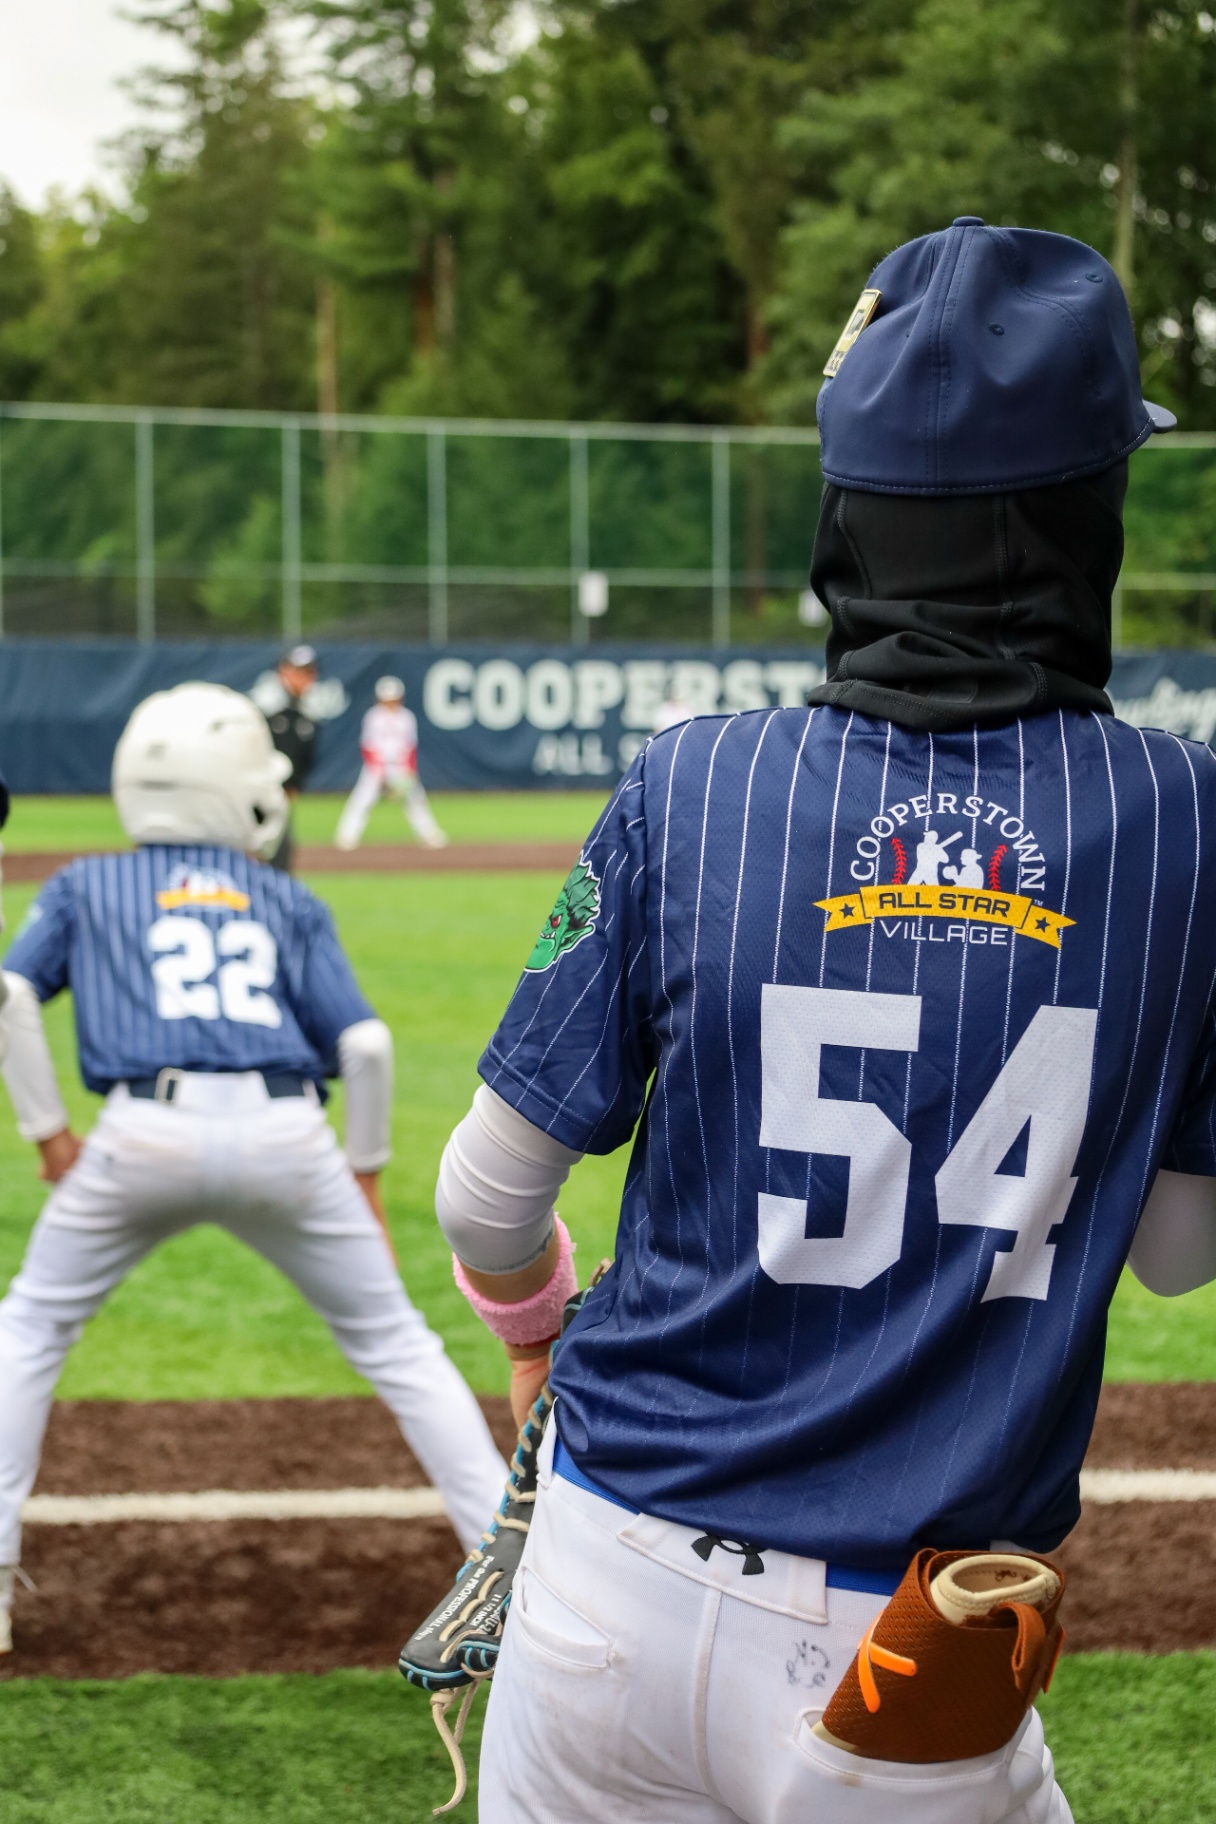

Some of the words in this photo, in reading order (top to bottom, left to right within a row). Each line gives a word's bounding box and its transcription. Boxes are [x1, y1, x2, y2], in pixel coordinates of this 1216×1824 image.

[423, 658, 827, 731] COOPERST
[532, 731, 614, 776] ALL
[850, 792, 1046, 891] COOPERSTOWN
[878, 892, 932, 909] ALL
[938, 894, 1011, 918] STAR
[879, 919, 1009, 946] VILLAGE
[147, 914, 283, 1030] 22
[757, 983, 1099, 1304] 54
[472, 1567, 486, 1579] the
[428, 1577, 480, 1628] PROFESSIONAL
